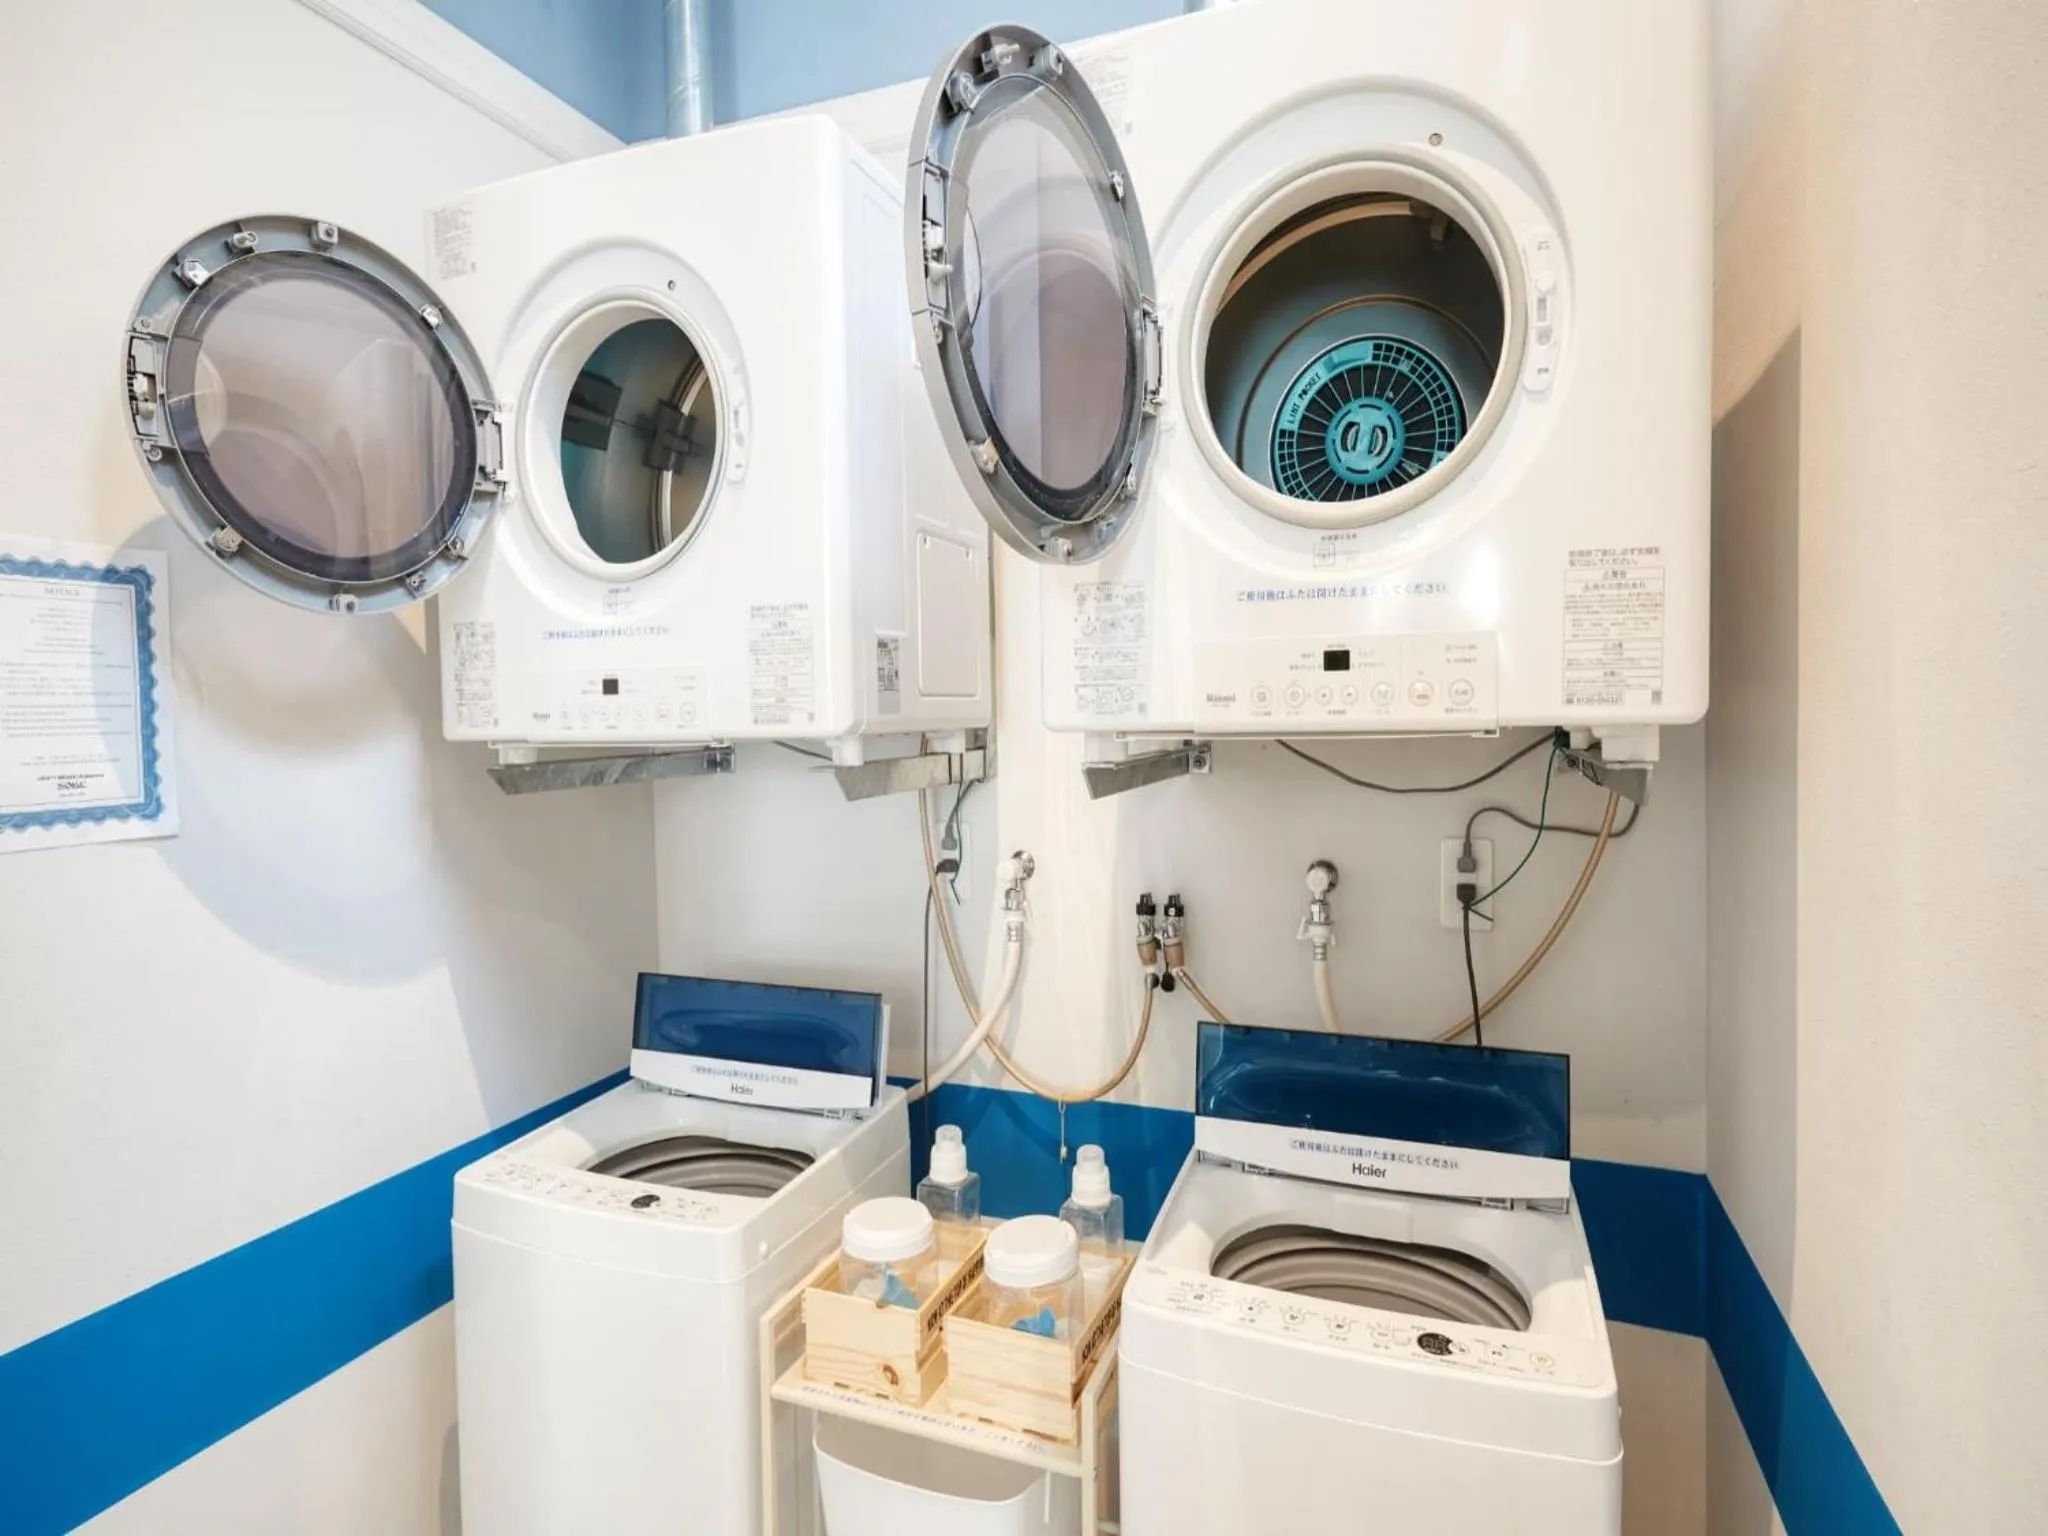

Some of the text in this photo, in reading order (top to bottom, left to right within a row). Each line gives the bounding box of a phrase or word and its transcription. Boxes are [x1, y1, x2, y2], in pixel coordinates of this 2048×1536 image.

[1237, 583, 1449, 602] ご使用後はふたは開けたままてください
[730, 1082, 754, 1095] Haier
[1352, 1162, 1387, 1179] Haier
